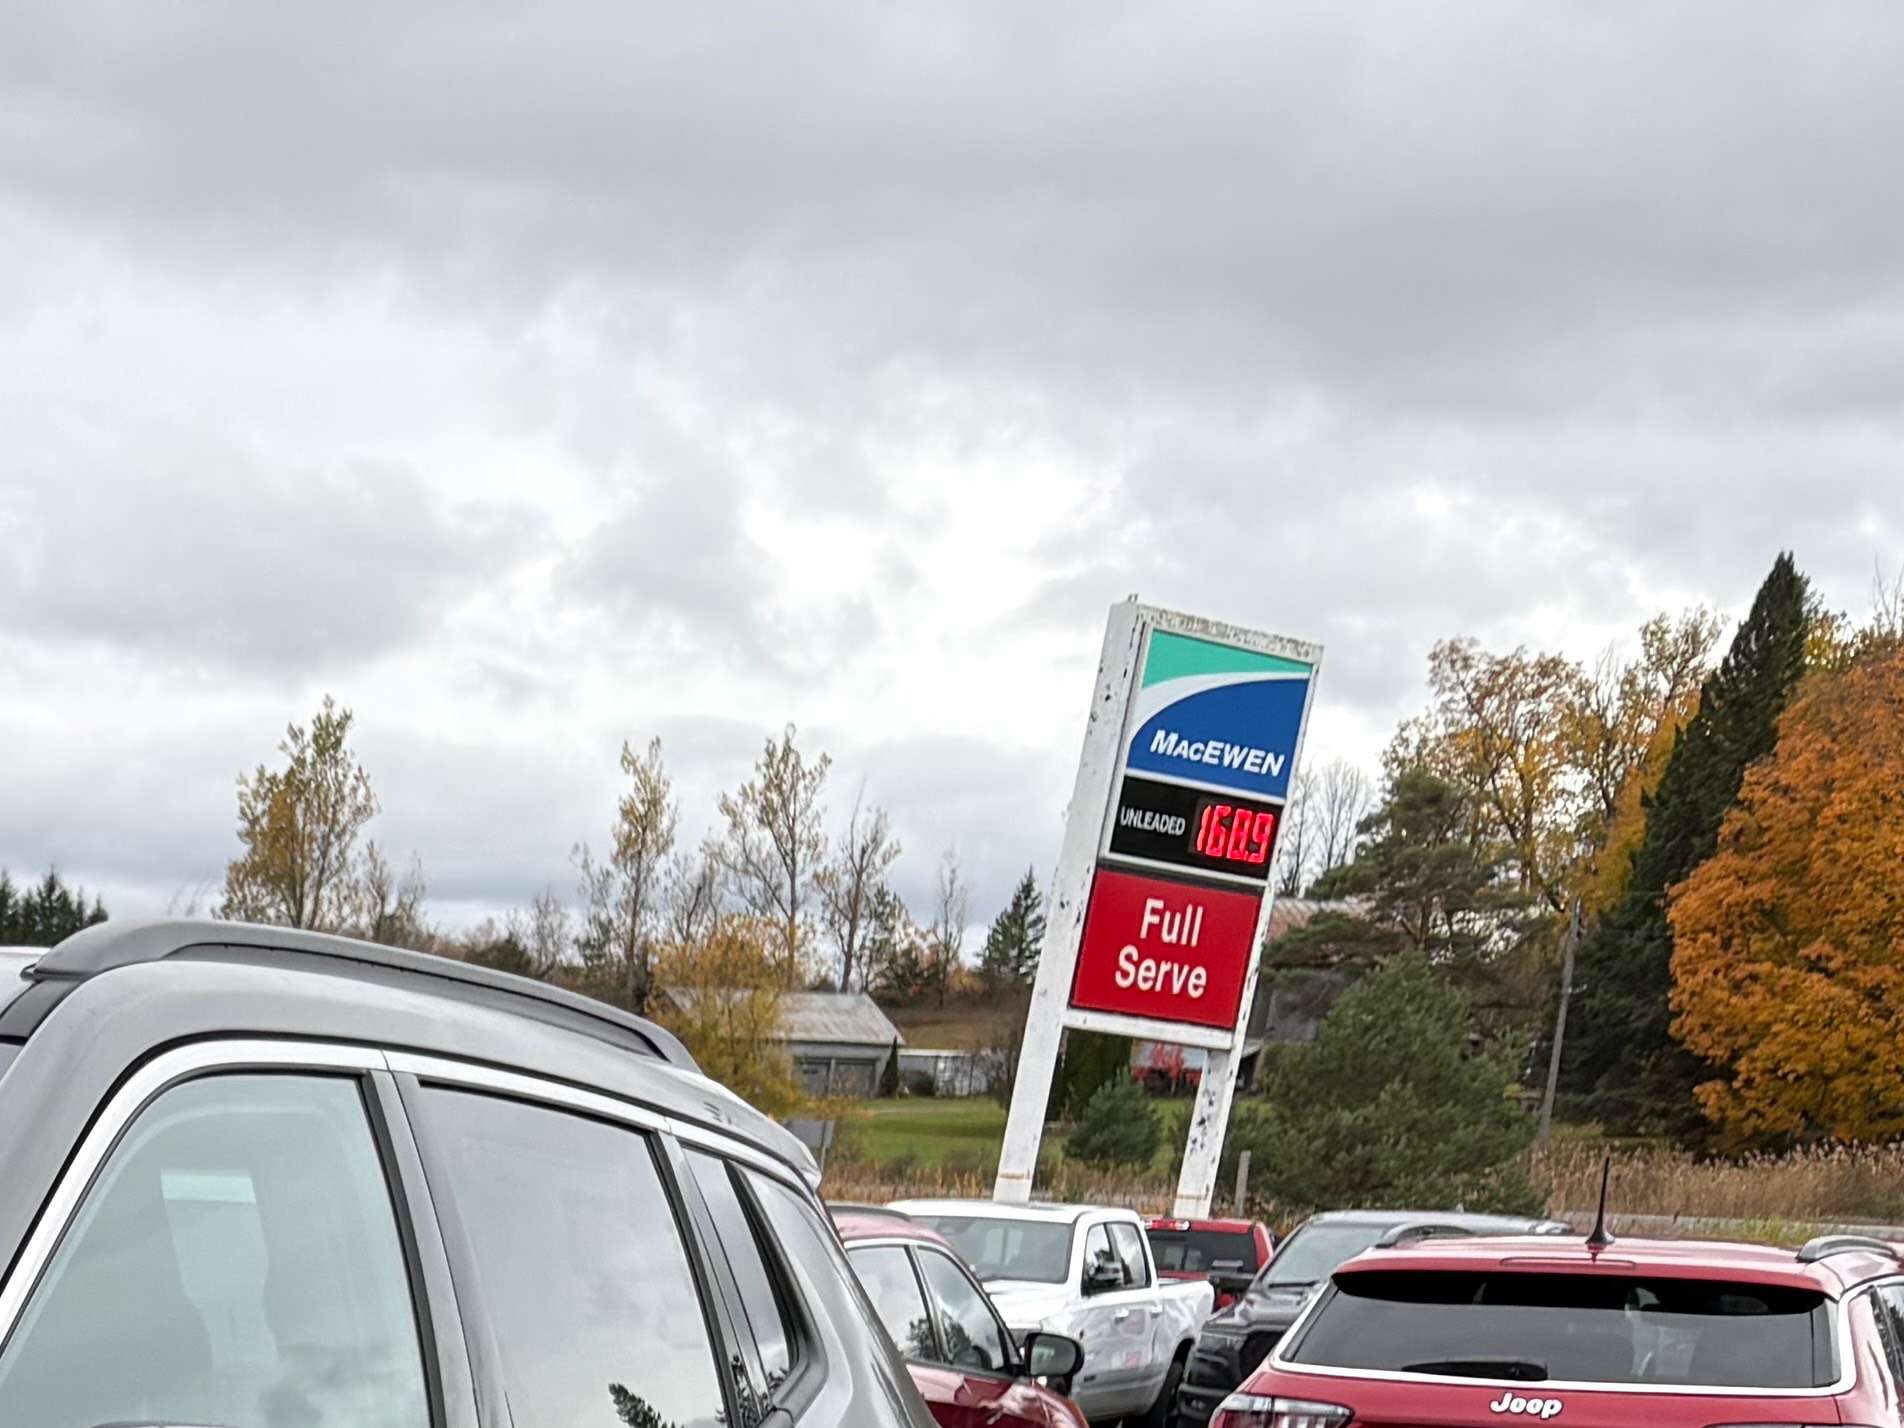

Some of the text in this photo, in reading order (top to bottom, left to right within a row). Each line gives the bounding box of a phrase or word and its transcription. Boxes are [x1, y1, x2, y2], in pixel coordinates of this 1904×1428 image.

[1120, 806, 1186, 836] UNLEADED
[1140, 897, 1204, 947] Full
[1115, 944, 1207, 999] Serve
